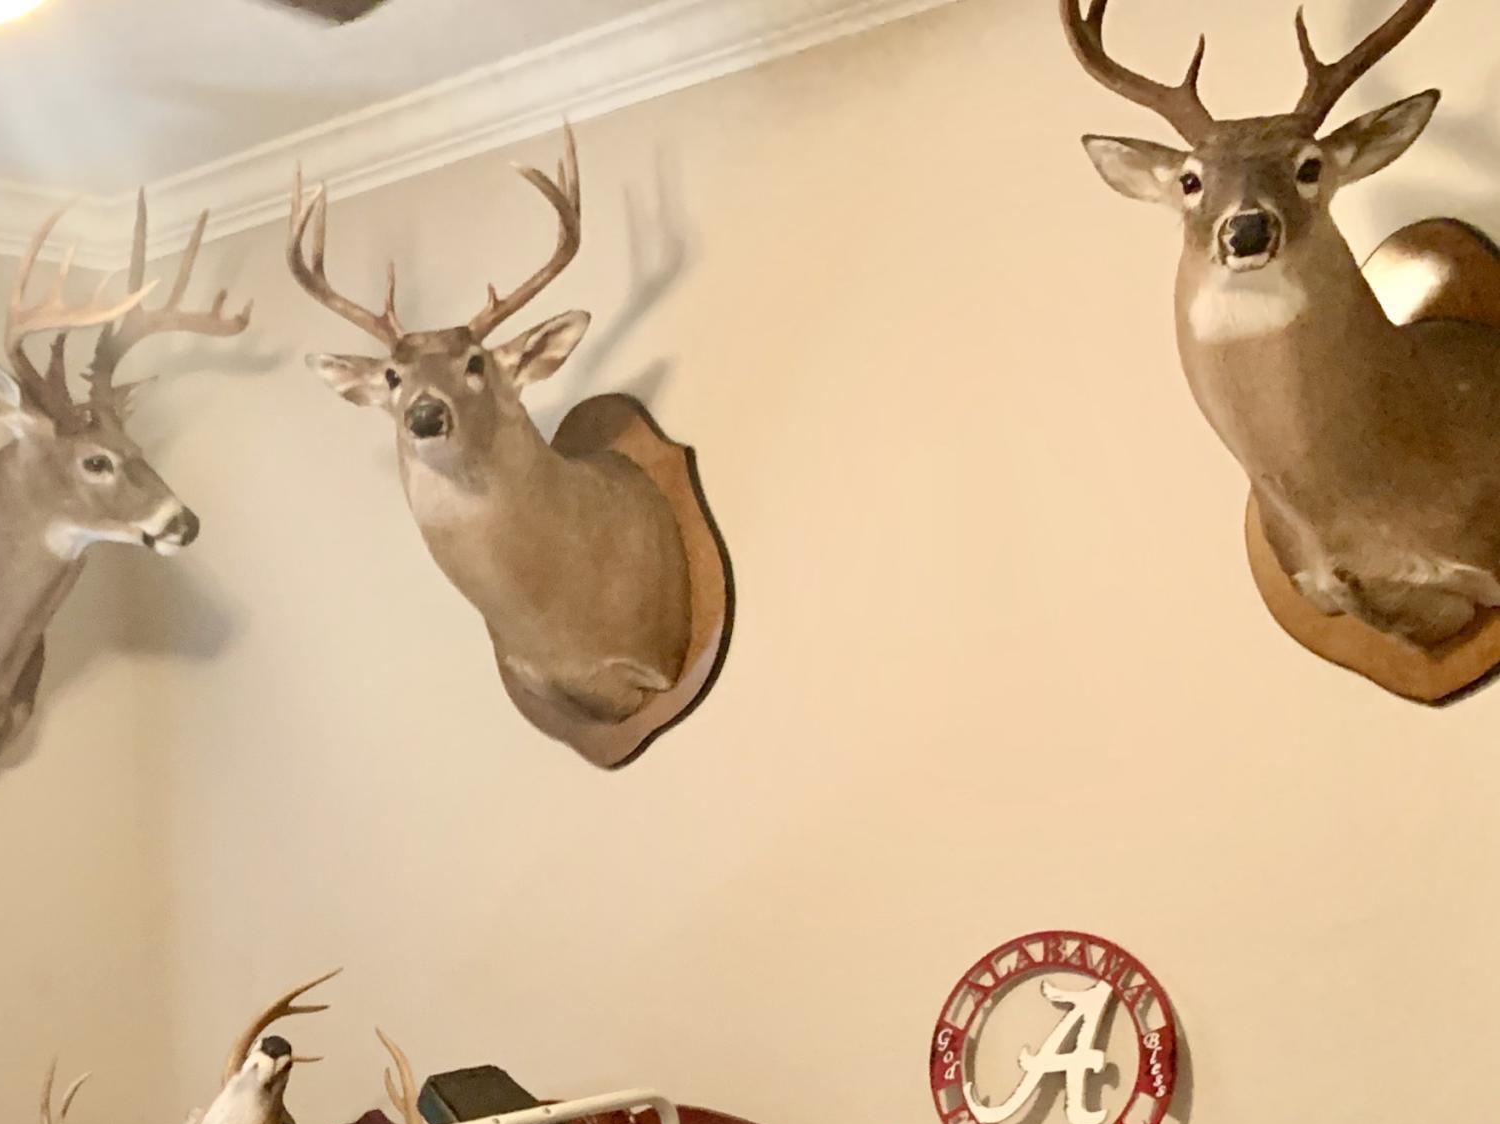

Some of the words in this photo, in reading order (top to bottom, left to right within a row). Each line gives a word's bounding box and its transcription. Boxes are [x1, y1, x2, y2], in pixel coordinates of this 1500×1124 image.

[961, 936, 1162, 1010] ALABAMA
[937, 1027, 961, 1081] God
[1143, 1032, 1166, 1098] Bless
